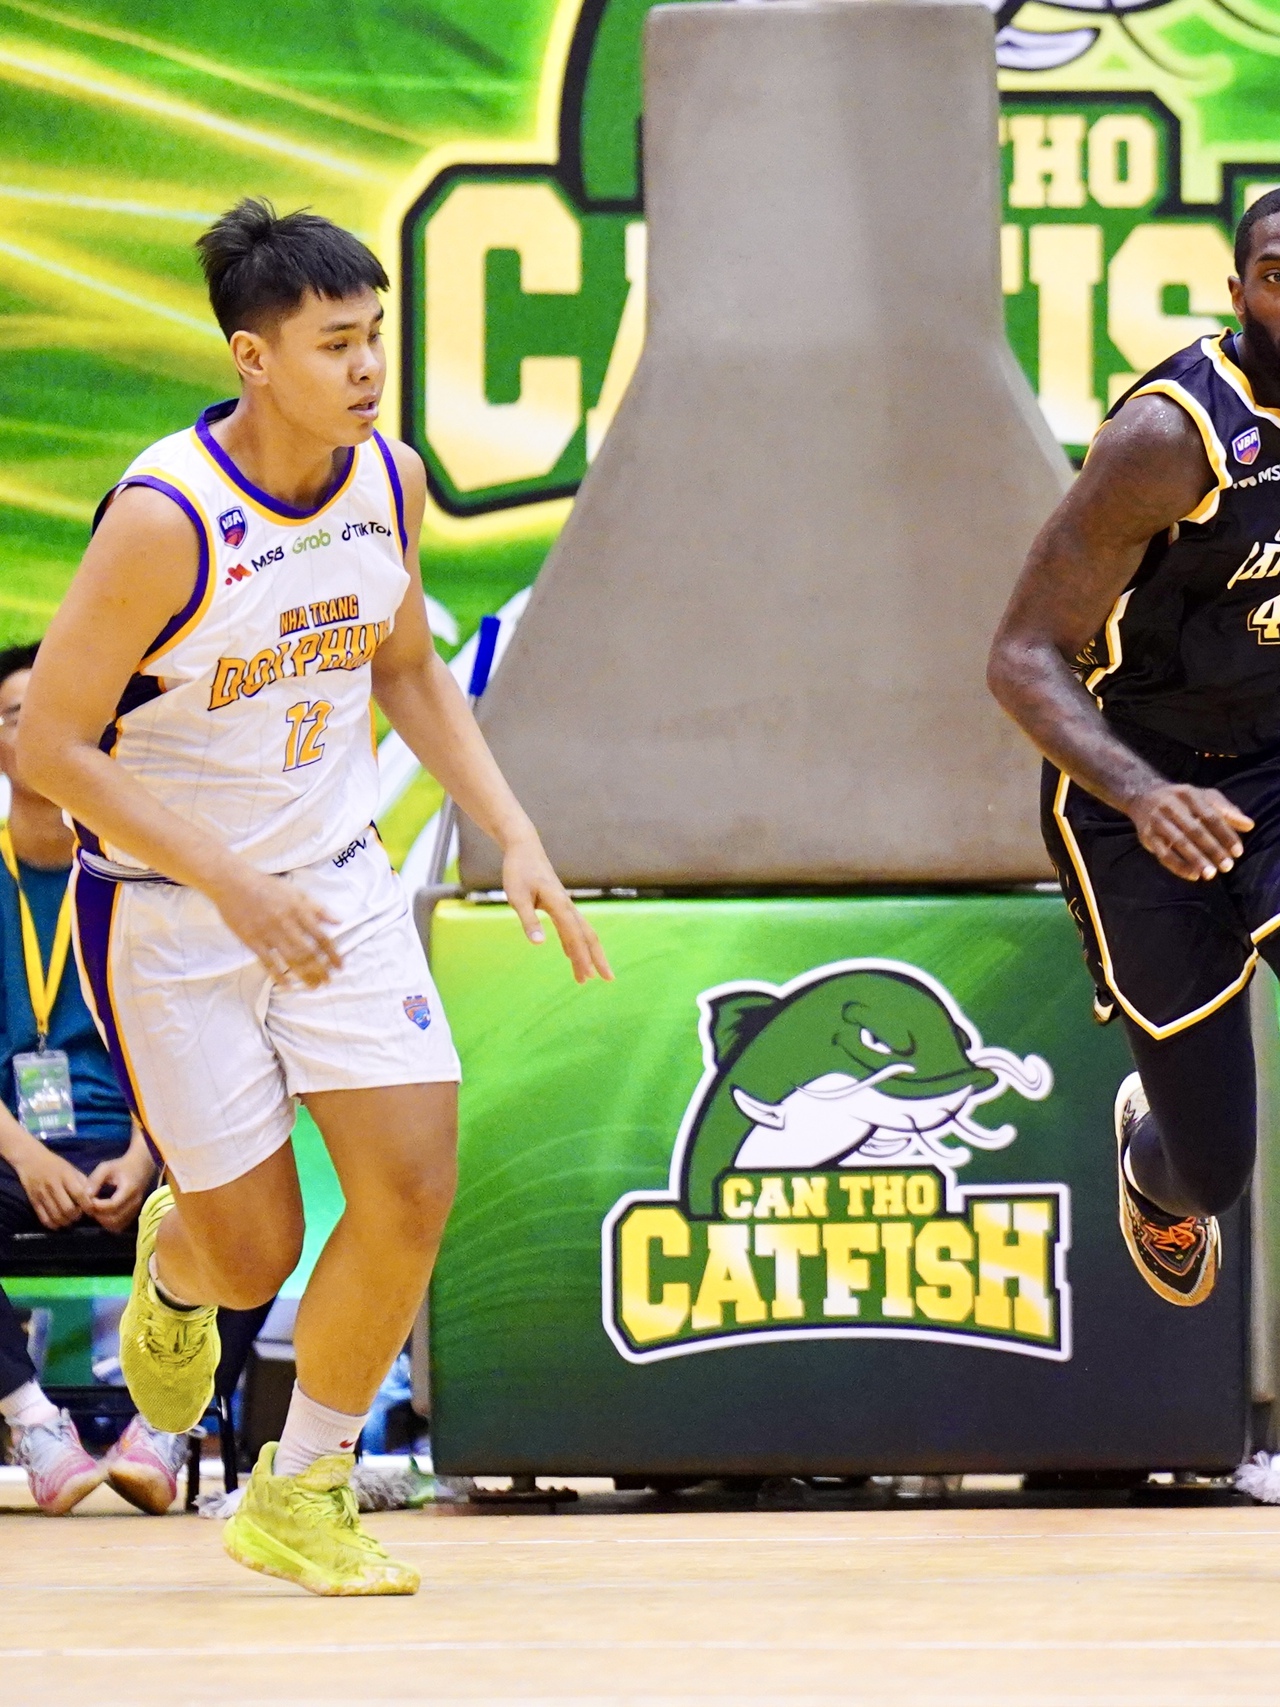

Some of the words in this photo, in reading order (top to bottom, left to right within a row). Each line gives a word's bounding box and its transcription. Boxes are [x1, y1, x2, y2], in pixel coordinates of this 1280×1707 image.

[1000, 114, 1158, 208] HO
[1236, 430, 1258, 452] VBA
[251, 546, 285, 572] MSB
[292, 529, 331, 554] Grab
[352, 521, 392, 538] TikTo
[279, 606, 310, 638] NHA
[309, 594, 360, 628] TRANG
[282, 700, 335, 772] 12
[722, 1175, 828, 1219] CAN
[838, 1174, 939, 1217] THO
[620, 1201, 1052, 1344] CATFISH
